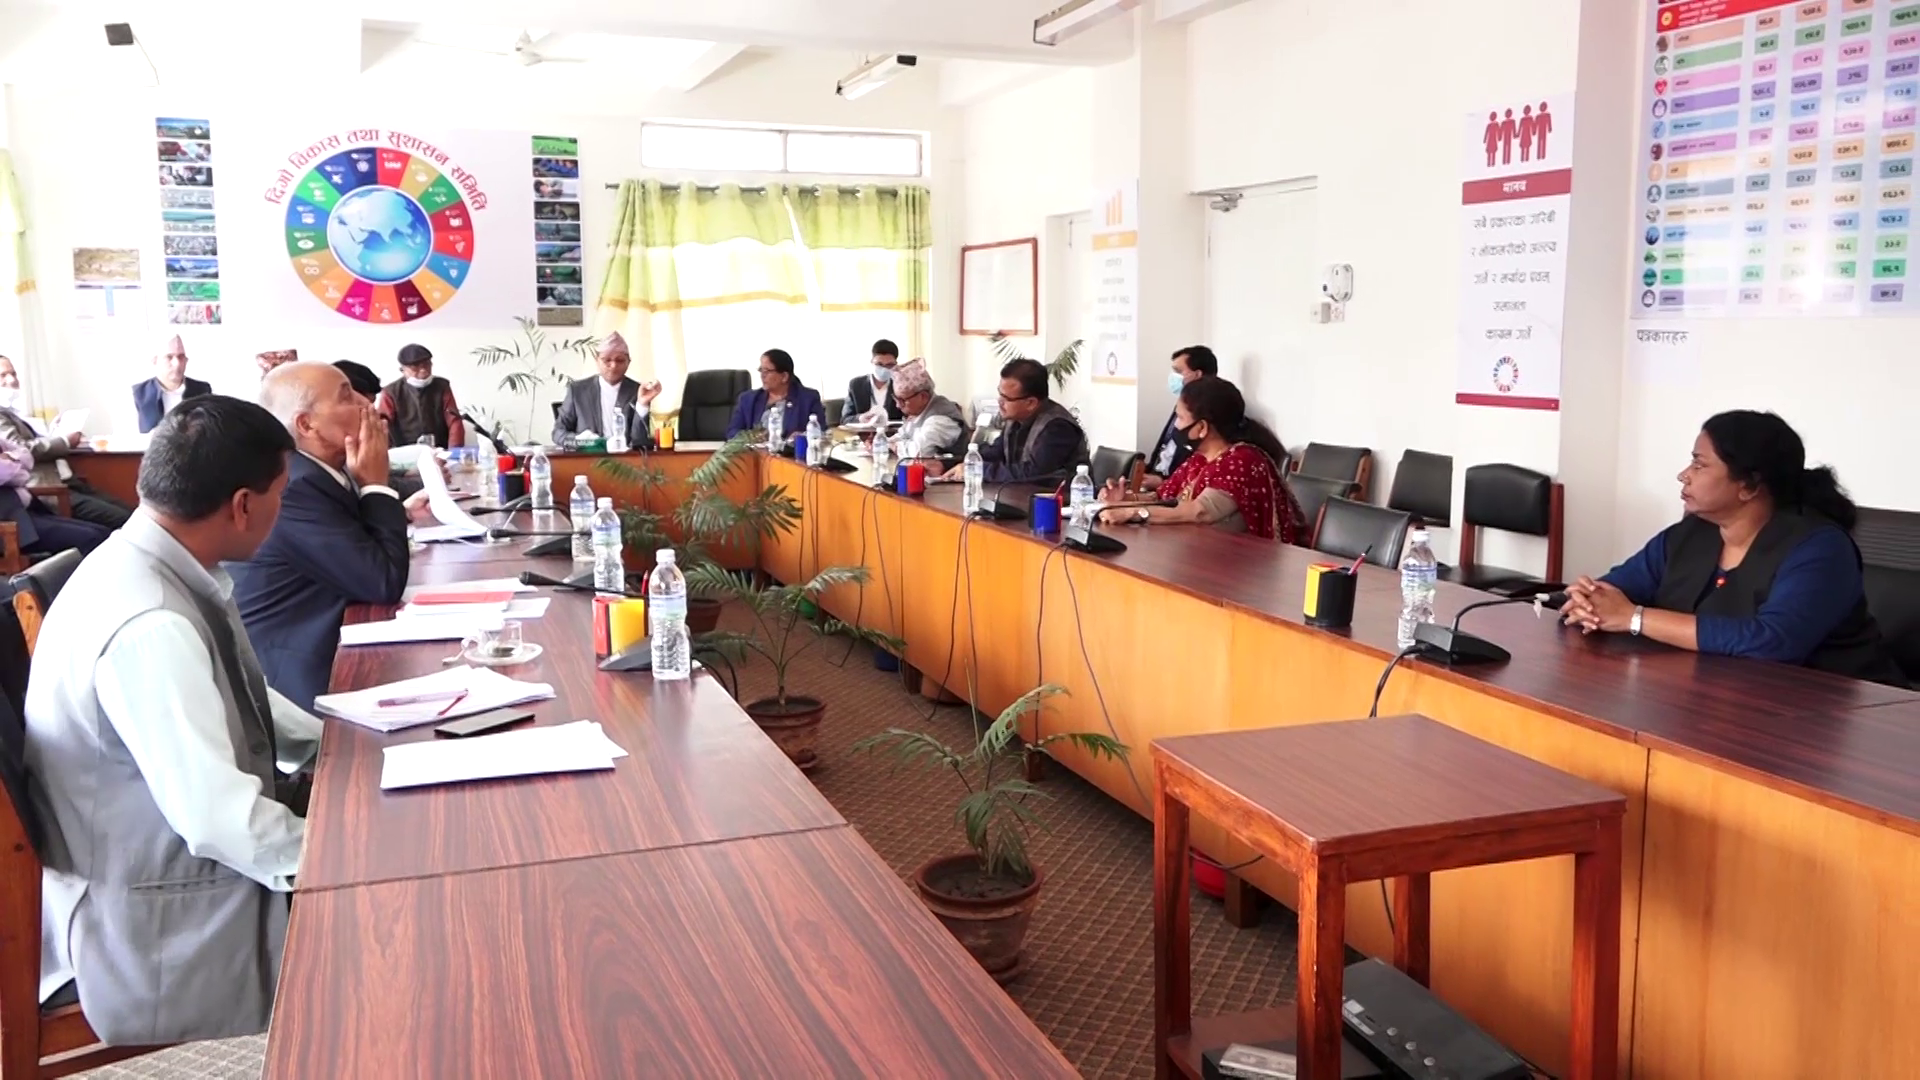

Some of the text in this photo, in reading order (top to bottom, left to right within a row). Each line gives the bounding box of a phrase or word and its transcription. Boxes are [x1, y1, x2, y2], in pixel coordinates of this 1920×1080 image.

[264, 128, 488, 212] दिगो विकास तथा सुशासन समिति
